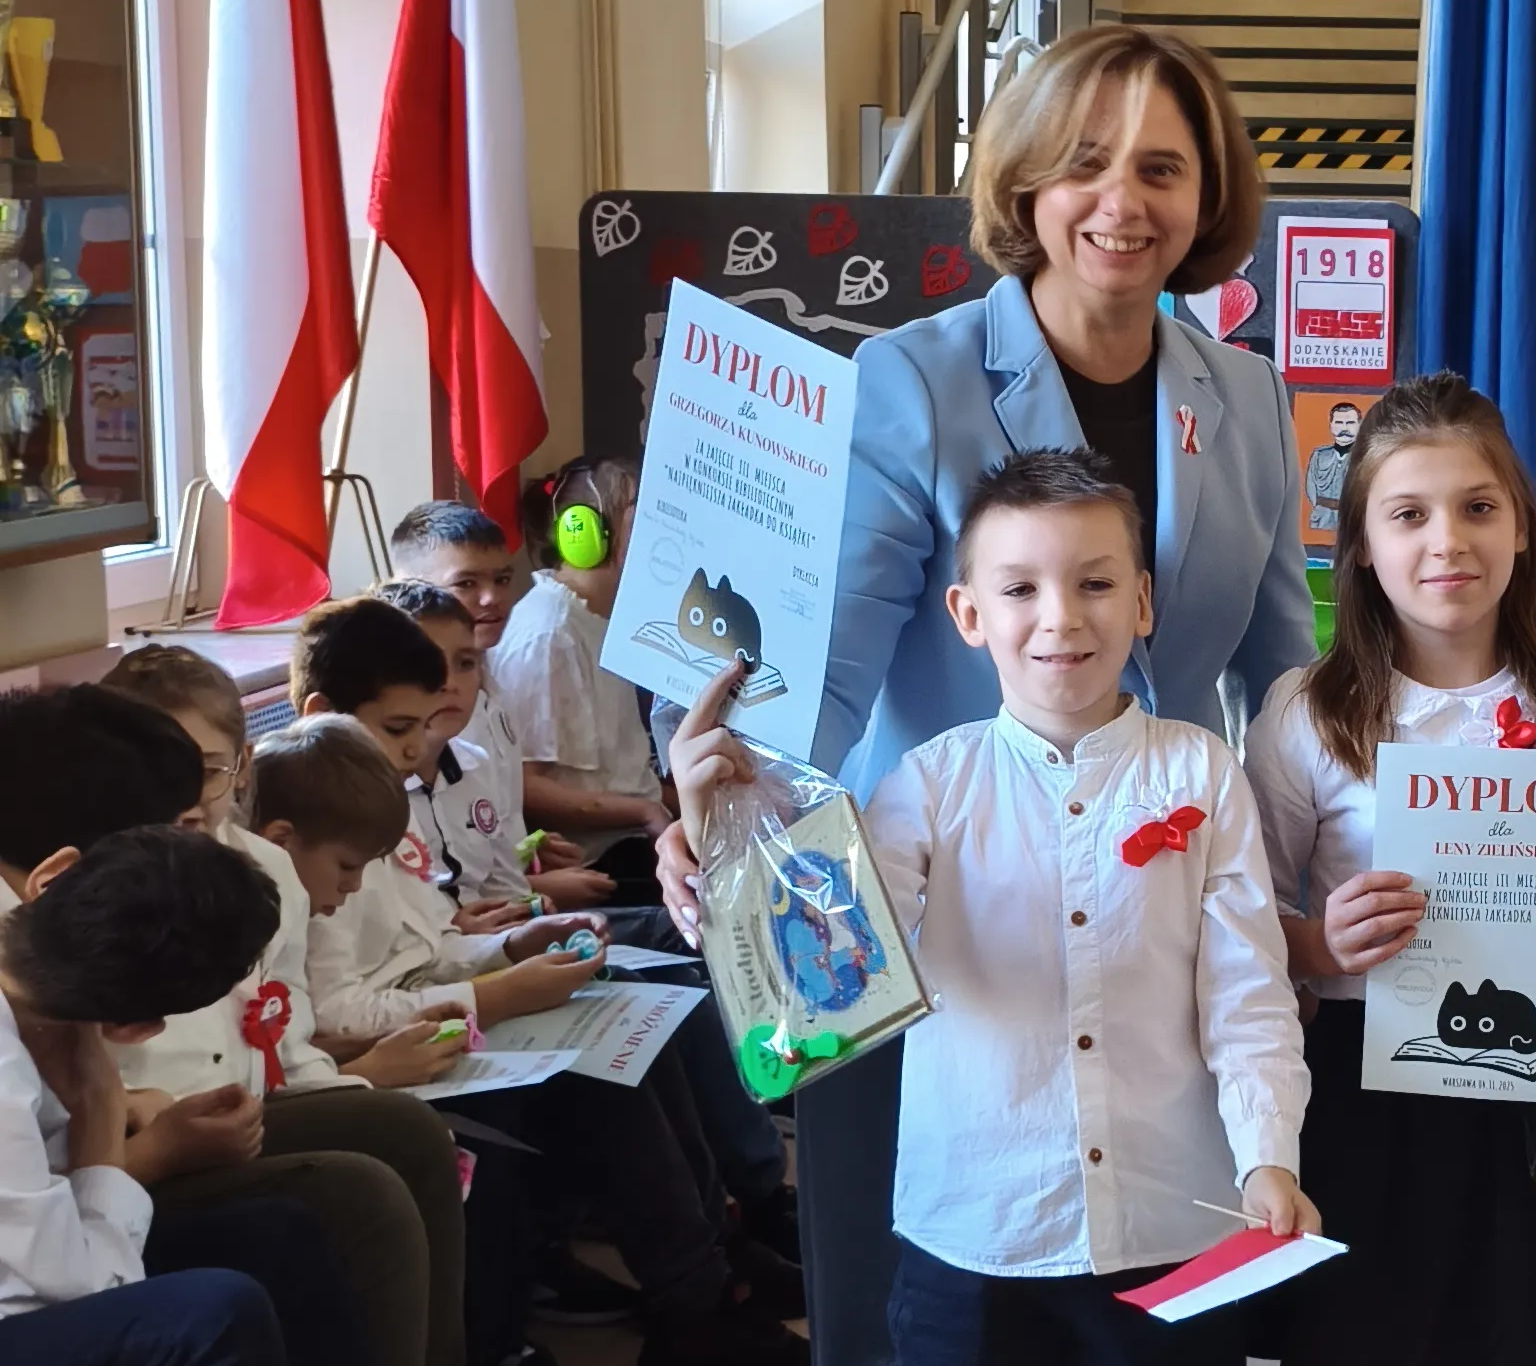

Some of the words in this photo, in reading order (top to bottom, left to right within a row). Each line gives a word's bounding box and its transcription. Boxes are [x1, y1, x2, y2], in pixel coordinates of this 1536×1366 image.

[1296, 247, 1385, 278] 1918
[1294, 344, 1384, 357] ODZYSKANIE
[1293, 356, 1384, 368] NIEPODLEGŁOŚCI
[683, 321, 828, 426] DYPLOM
[738, 400, 758, 421] dla
[669, 392, 735, 436] GRZEGORZA
[738, 425, 828, 478] KUNOWSKIEGO
[684, 453, 692, 469] W
[693, 458, 733, 491] KONKURSIE
[695, 438, 704, 456] ZA
[706, 443, 735, 471] ZAJĘCIE
[738, 459, 750, 478] III
[754, 467, 787, 496] MIEJSCA
[727, 495, 764, 527] ZAKŁADKA
[766, 514, 777, 532] DO
[1488, 820, 1515, 837] dla
[1435, 841, 1475, 856] LENY
[1437, 871, 1448, 885] ZA
[1451, 871, 1488, 889] ZAJĘCIE
[1496, 873, 1509, 887] III
[1424, 888, 1432, 902] W
[1435, 888, 1489, 905] KONKURSIE
[1424, 905, 1481, 923] IĘKNIEJSZA
[1485, 908, 1532, 924] ZAKŁADKA
